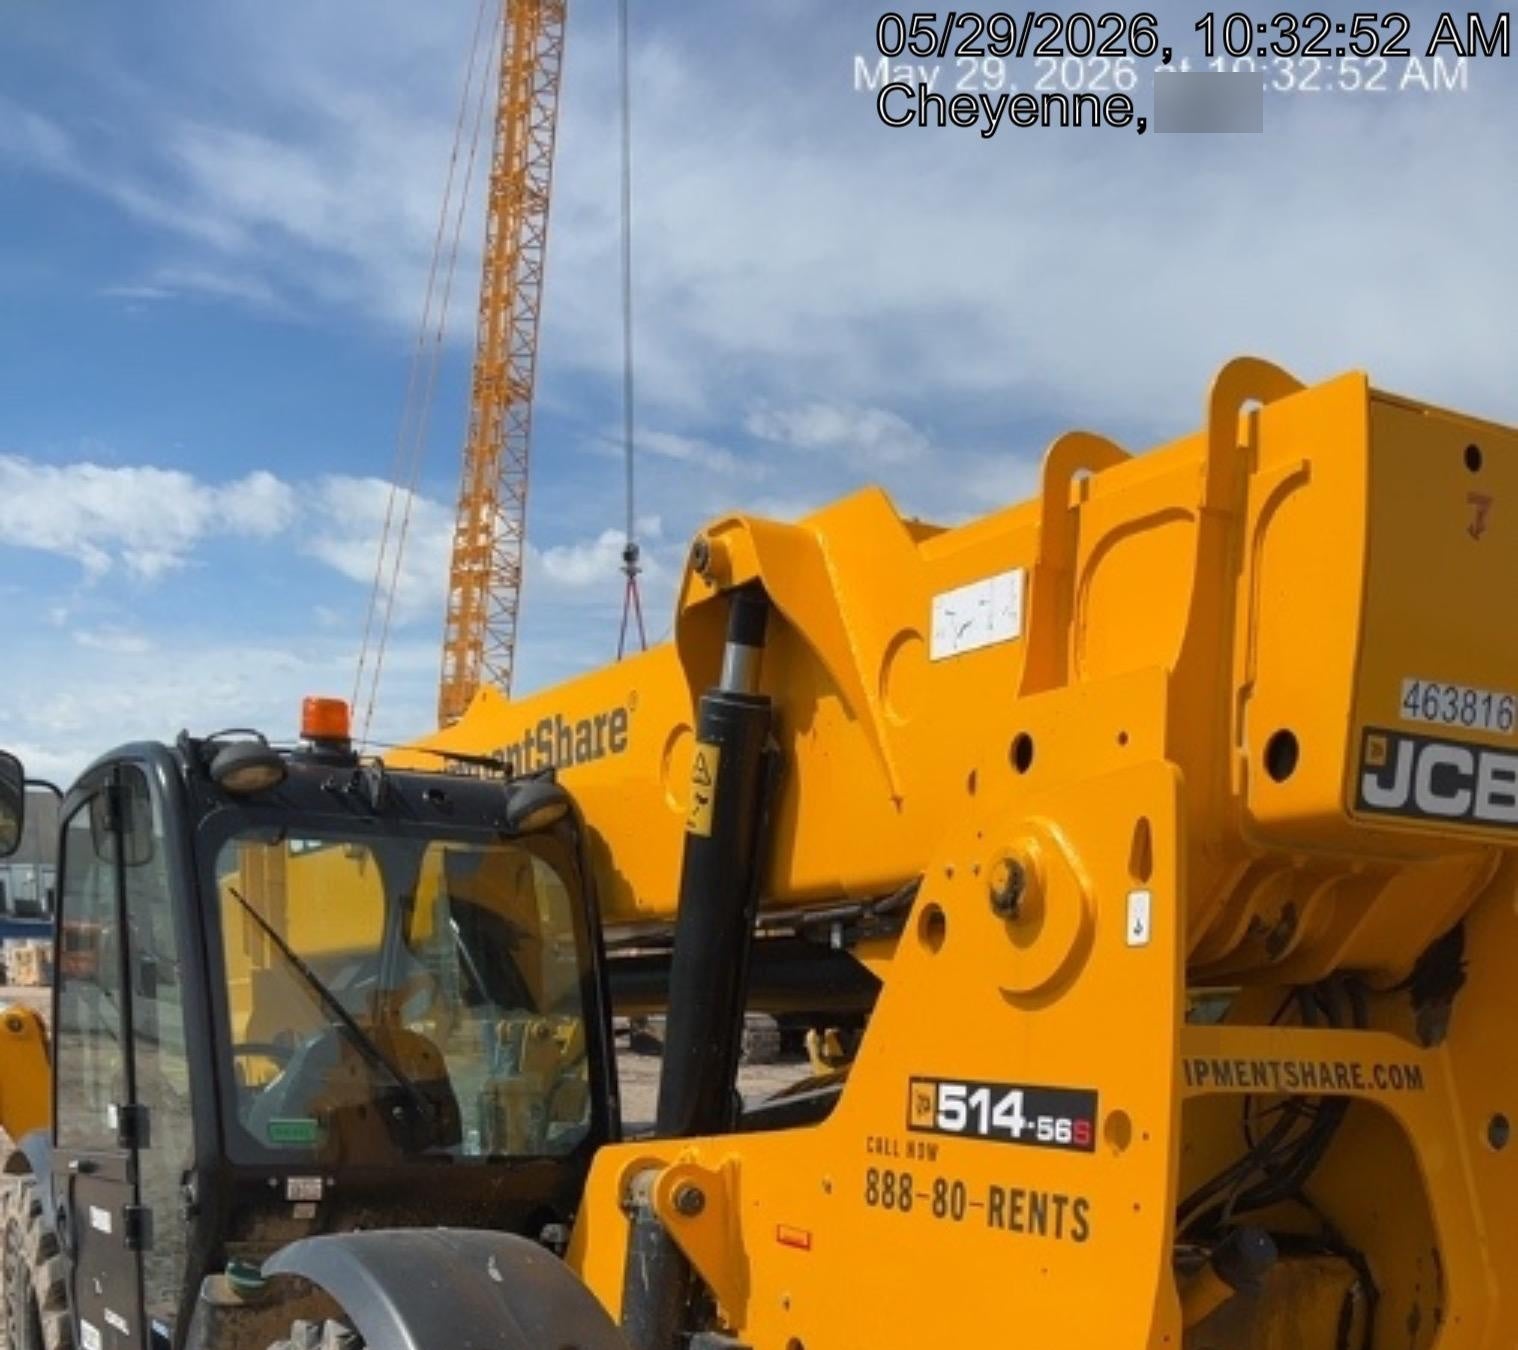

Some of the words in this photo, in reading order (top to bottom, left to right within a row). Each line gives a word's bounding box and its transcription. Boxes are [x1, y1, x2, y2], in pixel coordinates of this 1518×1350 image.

[1403, 679, 1515, 731] 463816
[1361, 739, 1518, 822] JCB
[866, 1135, 900, 1158] CALL
[905, 1140, 940, 1162] NOW
[865, 1166, 1090, 1243] 888-80-RENTS
